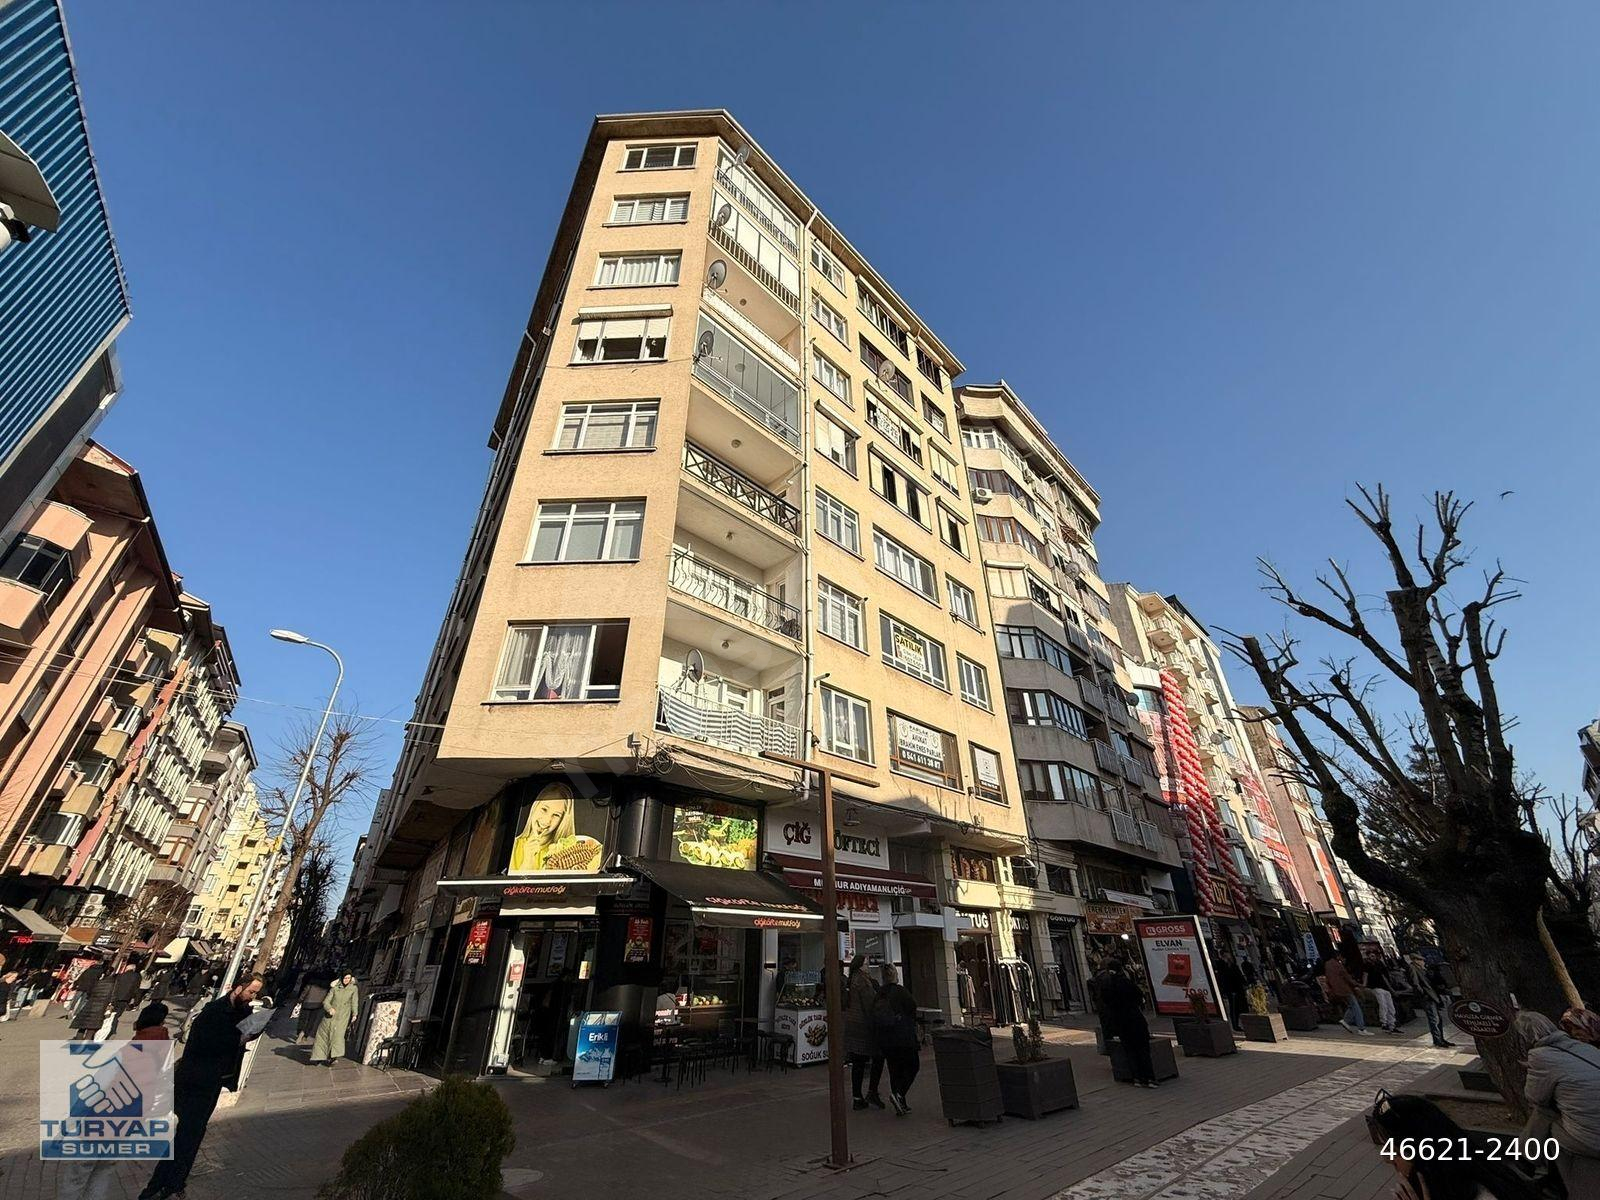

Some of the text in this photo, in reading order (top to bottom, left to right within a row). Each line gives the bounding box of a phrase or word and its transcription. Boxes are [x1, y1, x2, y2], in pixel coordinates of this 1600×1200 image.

[894, 634, 923, 656] SATILIK
[783, 821, 881, 857] ÇİĞ ÖFTECİ
[1156, 925, 1186, 934] GROSS
[1155, 939, 1183, 947] ELVAN
[801, 1050, 821, 1061] SOĞUK
